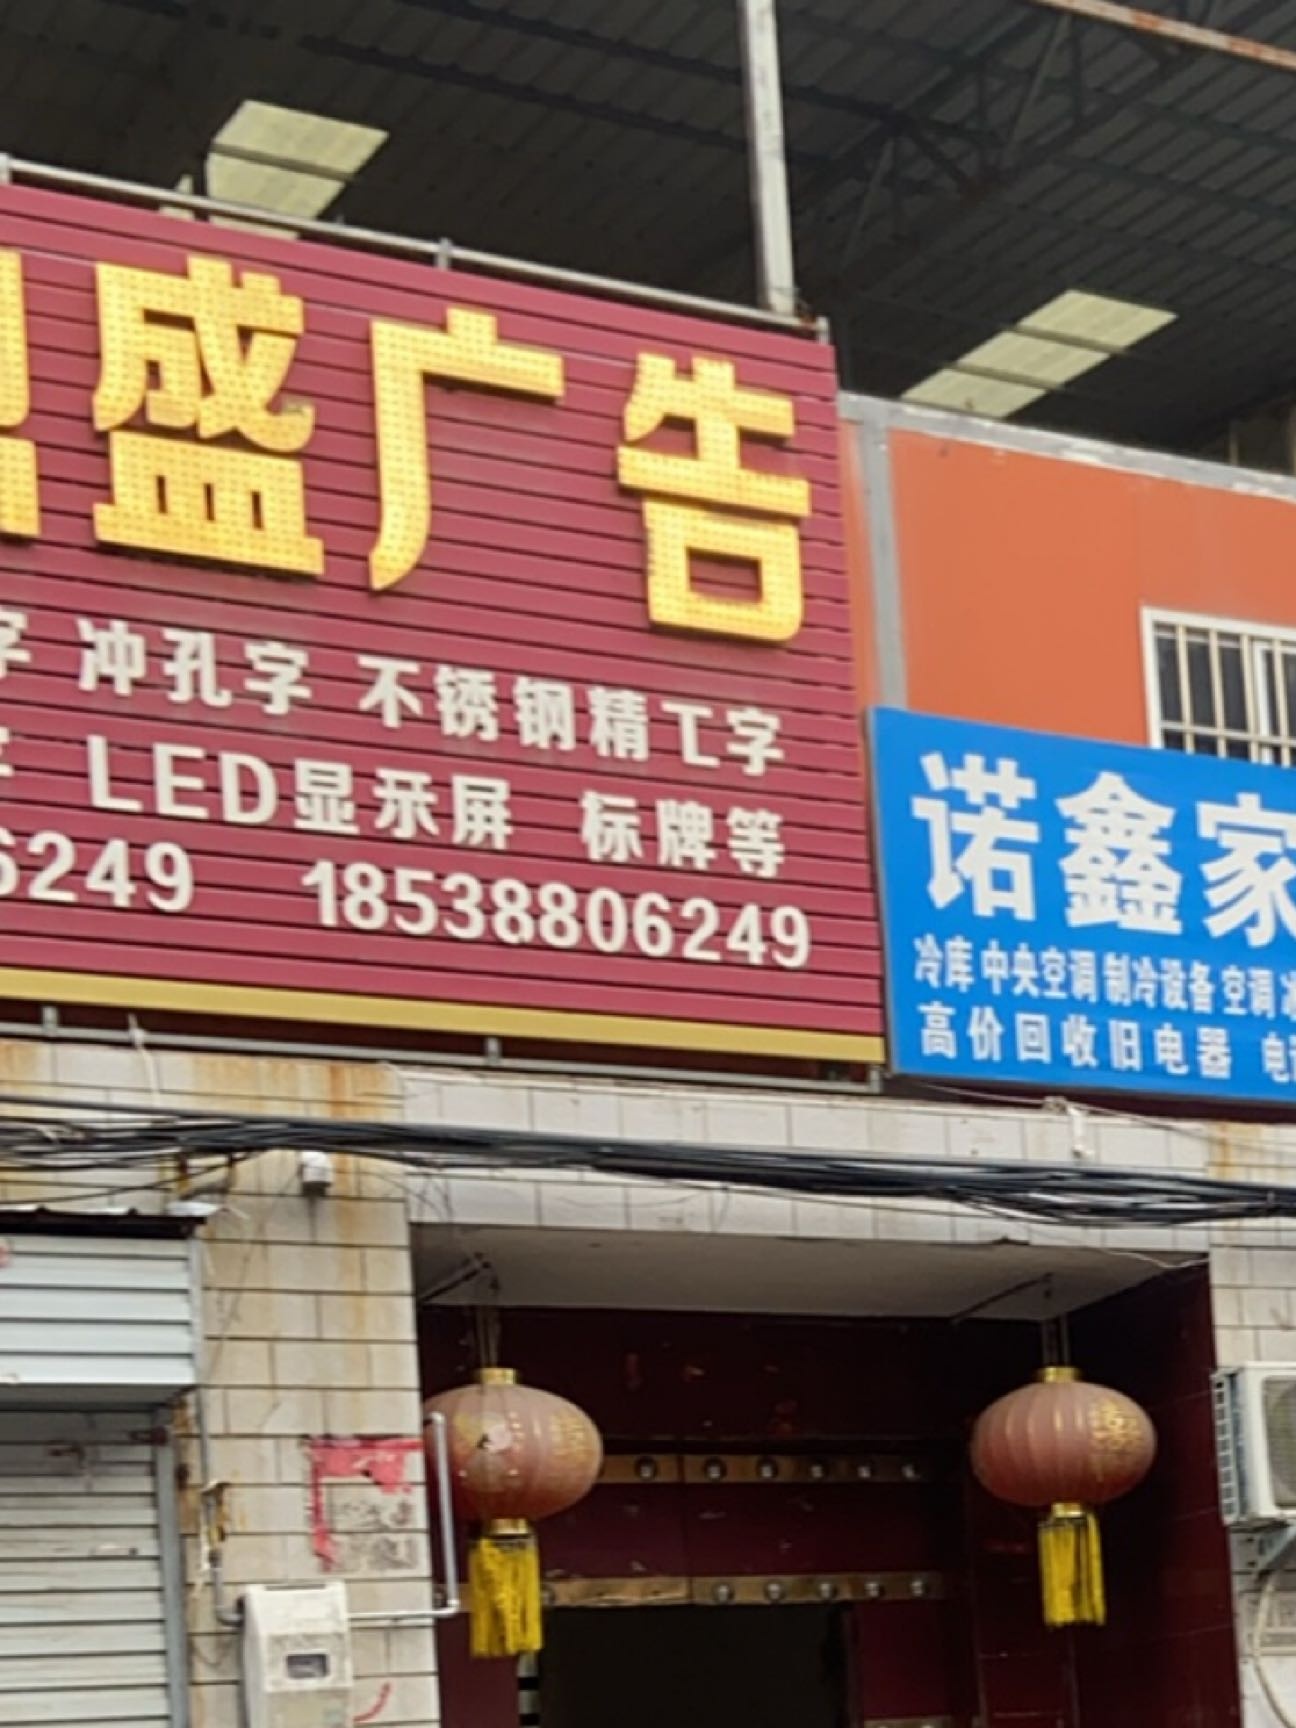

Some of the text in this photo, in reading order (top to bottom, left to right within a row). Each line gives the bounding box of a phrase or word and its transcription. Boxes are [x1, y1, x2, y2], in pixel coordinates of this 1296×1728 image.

[78, 617, 311, 717] 冲孔字
[357, 654, 786, 778] 不锈钢精工字
[580, 790, 787, 880] 标牌等
[302, 859, 812, 970] 18538806249
[913, 932, 974, 993] 冷库
[981, 940, 1098, 1003] 中央空调
[1103, 952, 1215, 1015] 制冷设备
[1221, 965, 1275, 1019] 空调
[917, 1000, 1232, 1080] 高价回收旧电器
